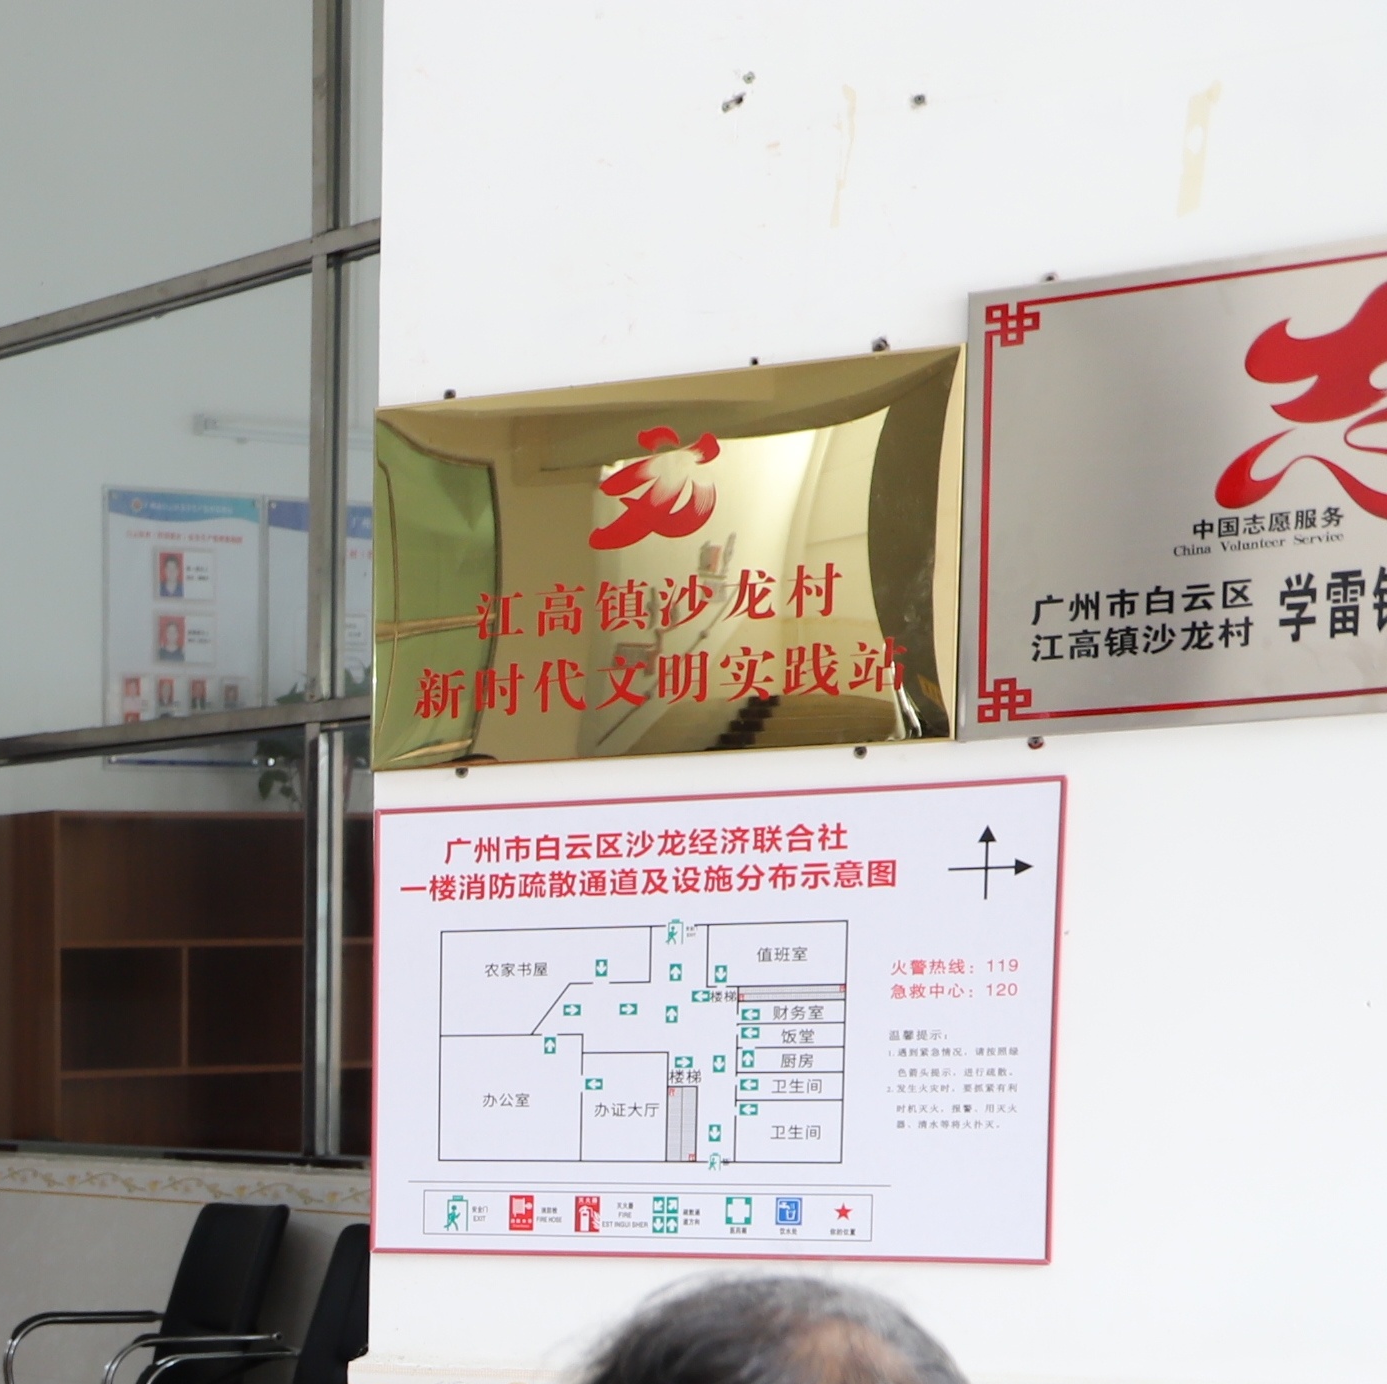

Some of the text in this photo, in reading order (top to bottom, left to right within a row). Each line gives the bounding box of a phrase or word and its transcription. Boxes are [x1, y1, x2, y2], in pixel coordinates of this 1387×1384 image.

[1192, 507, 1345, 540] 中国志愿服务
[1173, 532, 1345, 557] China Volunteer Service
[475, 562, 843, 641] 江高镇沙龙村
[1031, 578, 1254, 626] 广州市白云区
[1031, 616, 1254, 662] 江高镇沙龙村
[414, 636, 908, 720] 新时代文明实践站
[444, 822, 848, 865] 广州市白云区沙龙经济联合社
[400, 859, 897, 902] 一楼消防疏散通道及设施分布示意图
[757, 946, 809, 963] 值班室
[484, 961, 548, 978] 农家书屋
[711, 990, 737, 1003] 楼梯
[772, 1004, 825, 1021] 财务室
[781, 1028, 815, 1045] 饭堂
[780, 1052, 814, 1070] 厨房
[669, 1069, 702, 1085] 楼梯
[771, 1077, 824, 1095] 卫生间
[482, 1092, 531, 1109] 办公室
[593, 1102, 660, 1119] 办证大厅
[770, 1124, 823, 1142] 卫生间
